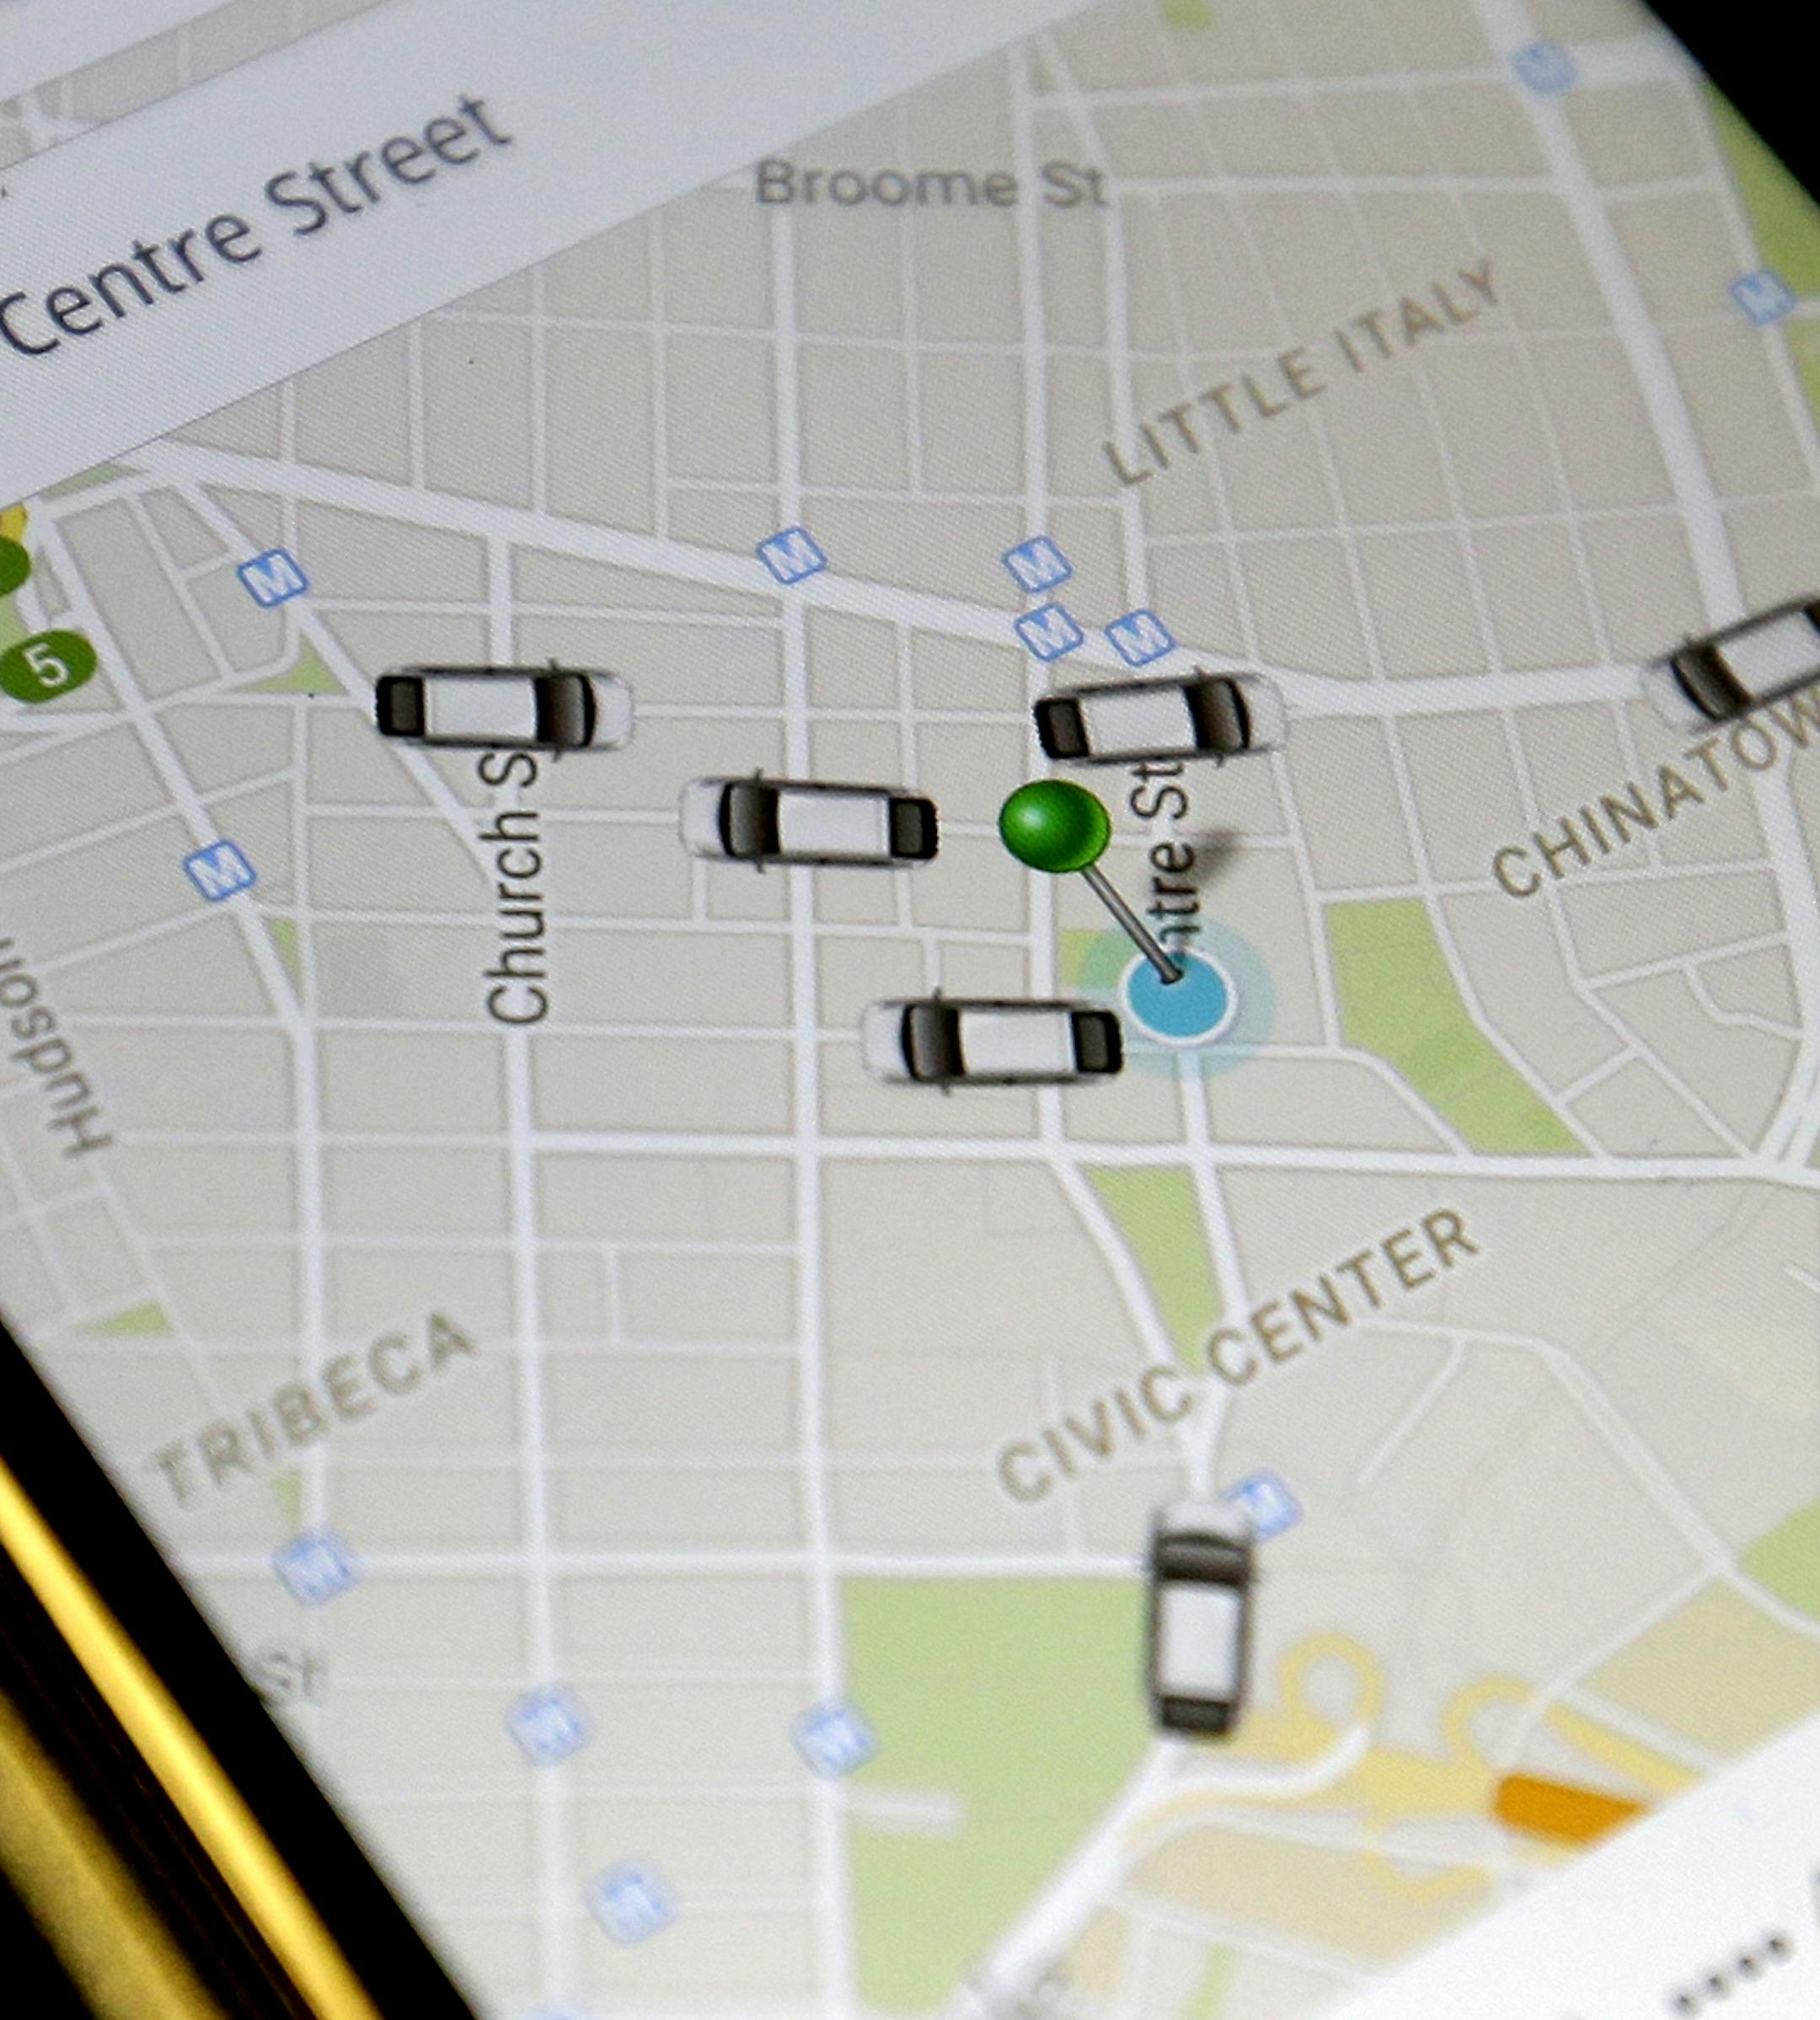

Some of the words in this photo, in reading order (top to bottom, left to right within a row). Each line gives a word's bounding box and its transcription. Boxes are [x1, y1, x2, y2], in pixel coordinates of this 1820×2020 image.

[756, 158, 1019, 206] Broome
[1041, 159, 1110, 208] St
[0, 212, 263, 356] Centre
[264, 93, 514, 238] Street
[1100, 346, 1328, 485] LITTLE
[1332, 256, 1500, 374] ITALY
[241, 550, 305, 604] M
[759, 529, 823, 582] M
[1005, 538, 1069, 591] M
[1017, 605, 1080, 659] M
[1108, 612, 1172, 664] M
[22, 643, 70, 689] 5
[186, 843, 253, 898] M
[482, 810, 550, 1026] Church
[997, 1366, 1193, 1503] CIVIC
[1206, 1206, 1480, 1386] CENTER
[142, 1309, 479, 1510] TRIBECA
